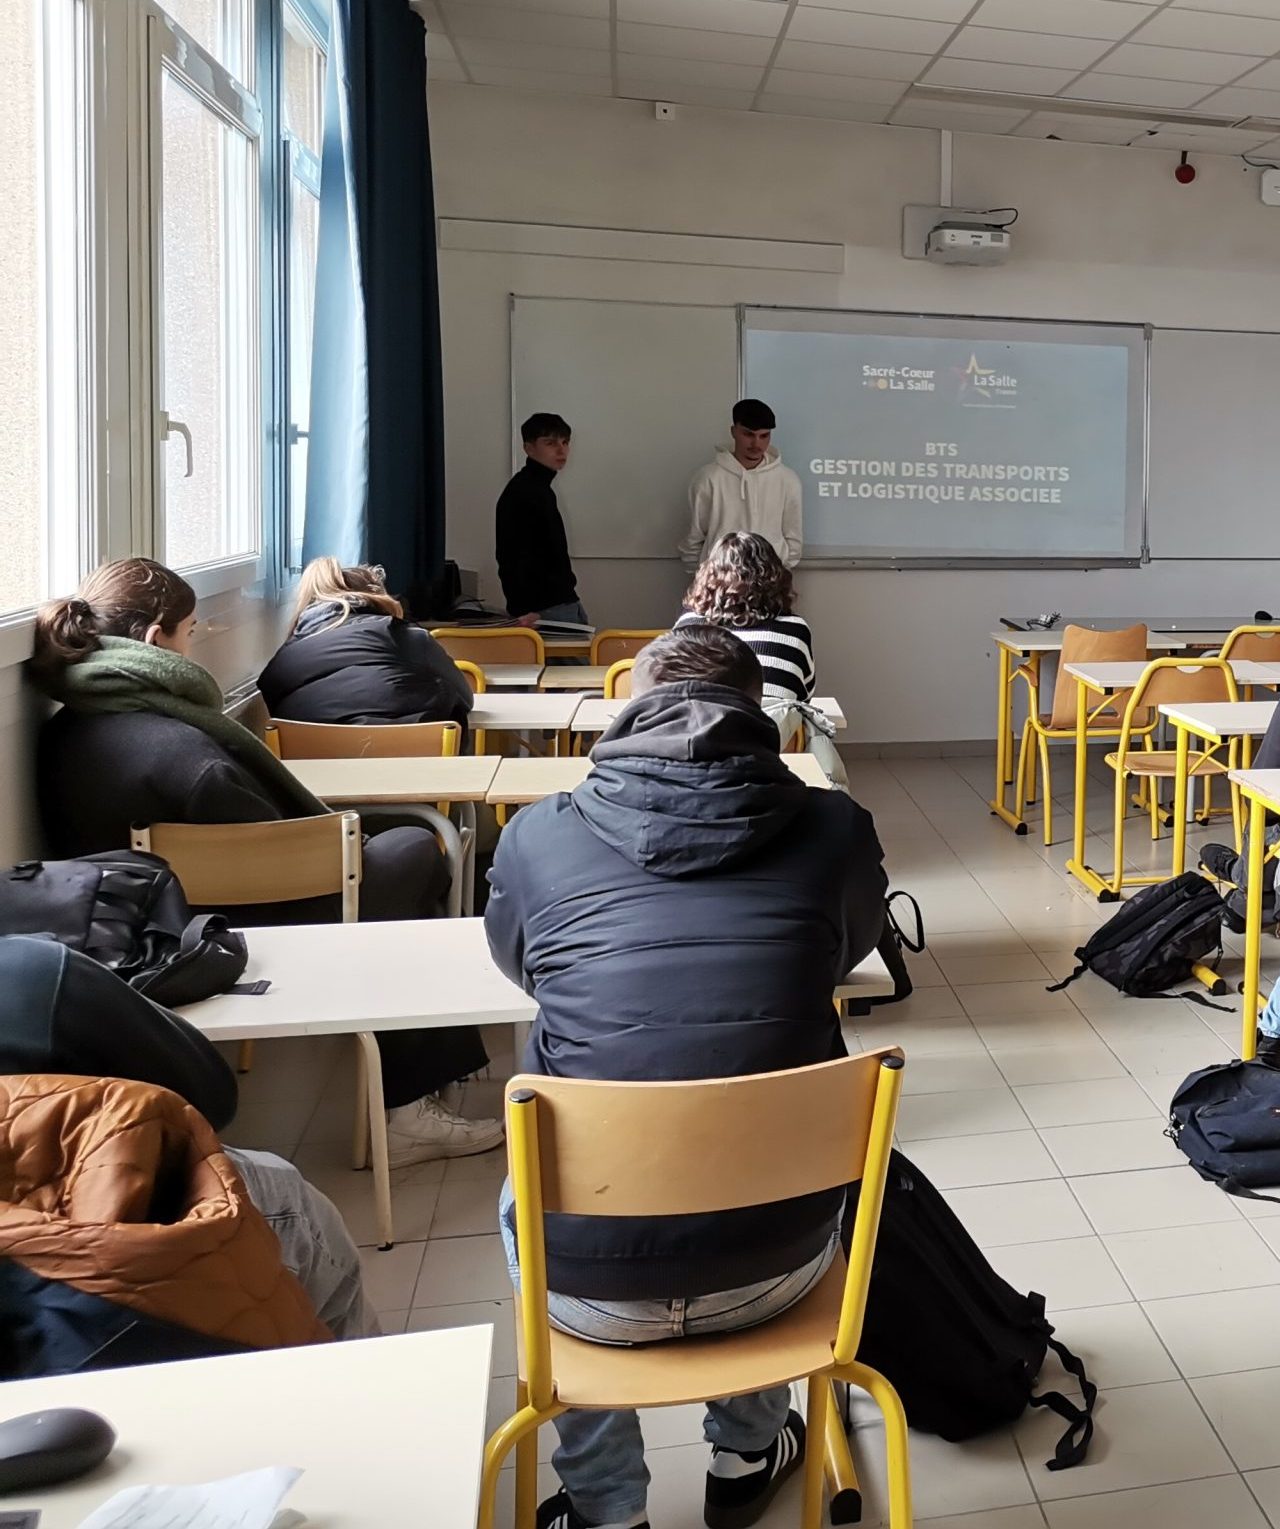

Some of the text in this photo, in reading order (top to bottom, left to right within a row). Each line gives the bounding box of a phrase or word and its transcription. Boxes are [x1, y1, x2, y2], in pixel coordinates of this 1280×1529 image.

[889, 378, 935, 392] La Salle
[925, 442, 959, 457] BTS
[809, 458, 1070, 482] GESTION DES TRANSPORTS
[818, 482, 1062, 504] ET LOGISTIQUE ASSOCIEE
